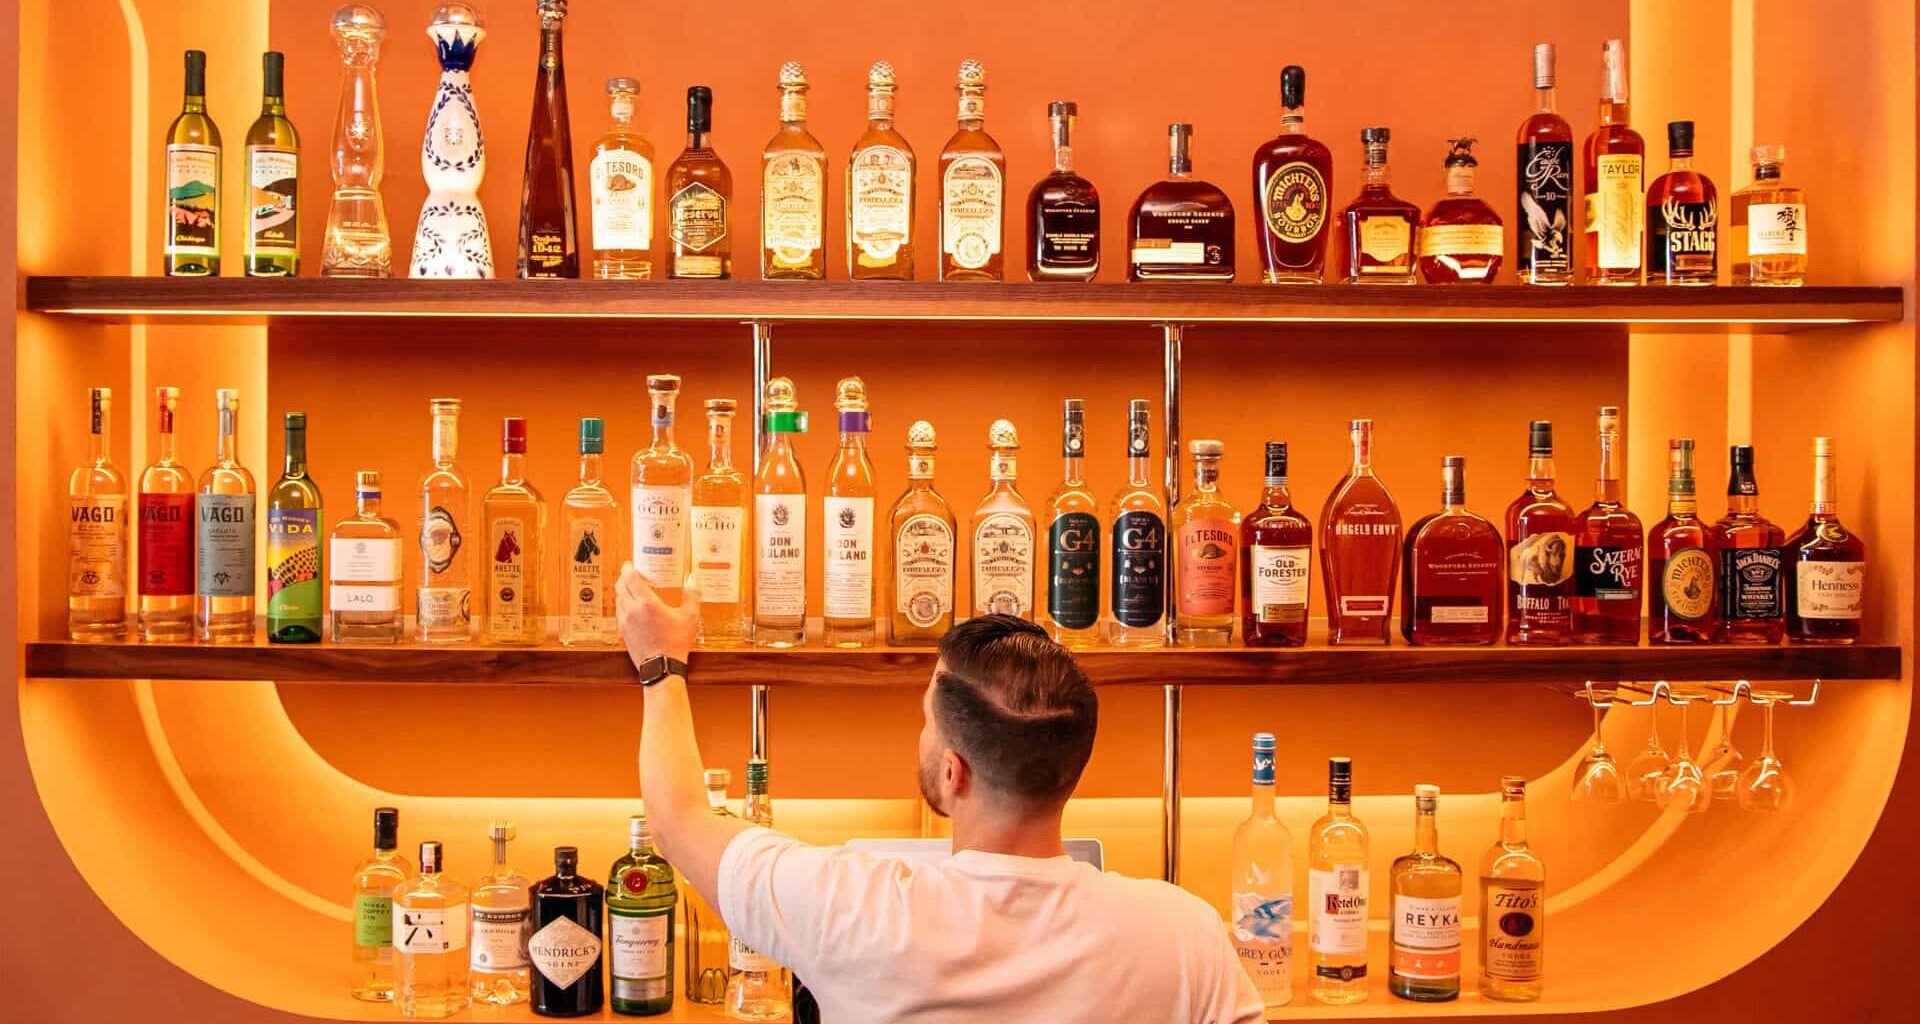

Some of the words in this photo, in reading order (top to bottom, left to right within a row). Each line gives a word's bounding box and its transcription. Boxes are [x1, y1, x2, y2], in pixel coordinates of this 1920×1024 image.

[1602, 164, 1640, 175] TAYLOR
[1271, 212, 1320, 234] BOURBON
[1671, 231, 1715, 252] STAGG
[72, 506, 115, 522] VAGO
[140, 505, 181, 522] VAGO
[201, 507, 245, 522] VAGO
[638, 504, 680, 515] OCHO
[269, 523, 313, 534] VIDA
[1373, 523, 1396, 535] ENVY
[770, 537, 792, 546] DON
[1060, 528, 1095, 551] G4
[1122, 528, 1159, 549] G4
[1197, 529, 1233, 547] TESORO
[1275, 559, 1295, 568] OLD
[1736, 555, 1753, 570] JACK
[1259, 566, 1307, 578] FORESTER
[1610, 563, 1639, 587] RYE
[346, 594, 374, 603] LALO
[1517, 594, 1549, 610] BUFFALO
[1327, 895, 1353, 910] Ketel
[1495, 892, 1537, 909] Tito's
[1406, 912, 1459, 926] REYKA
[1237, 947, 1264, 960] GREY
